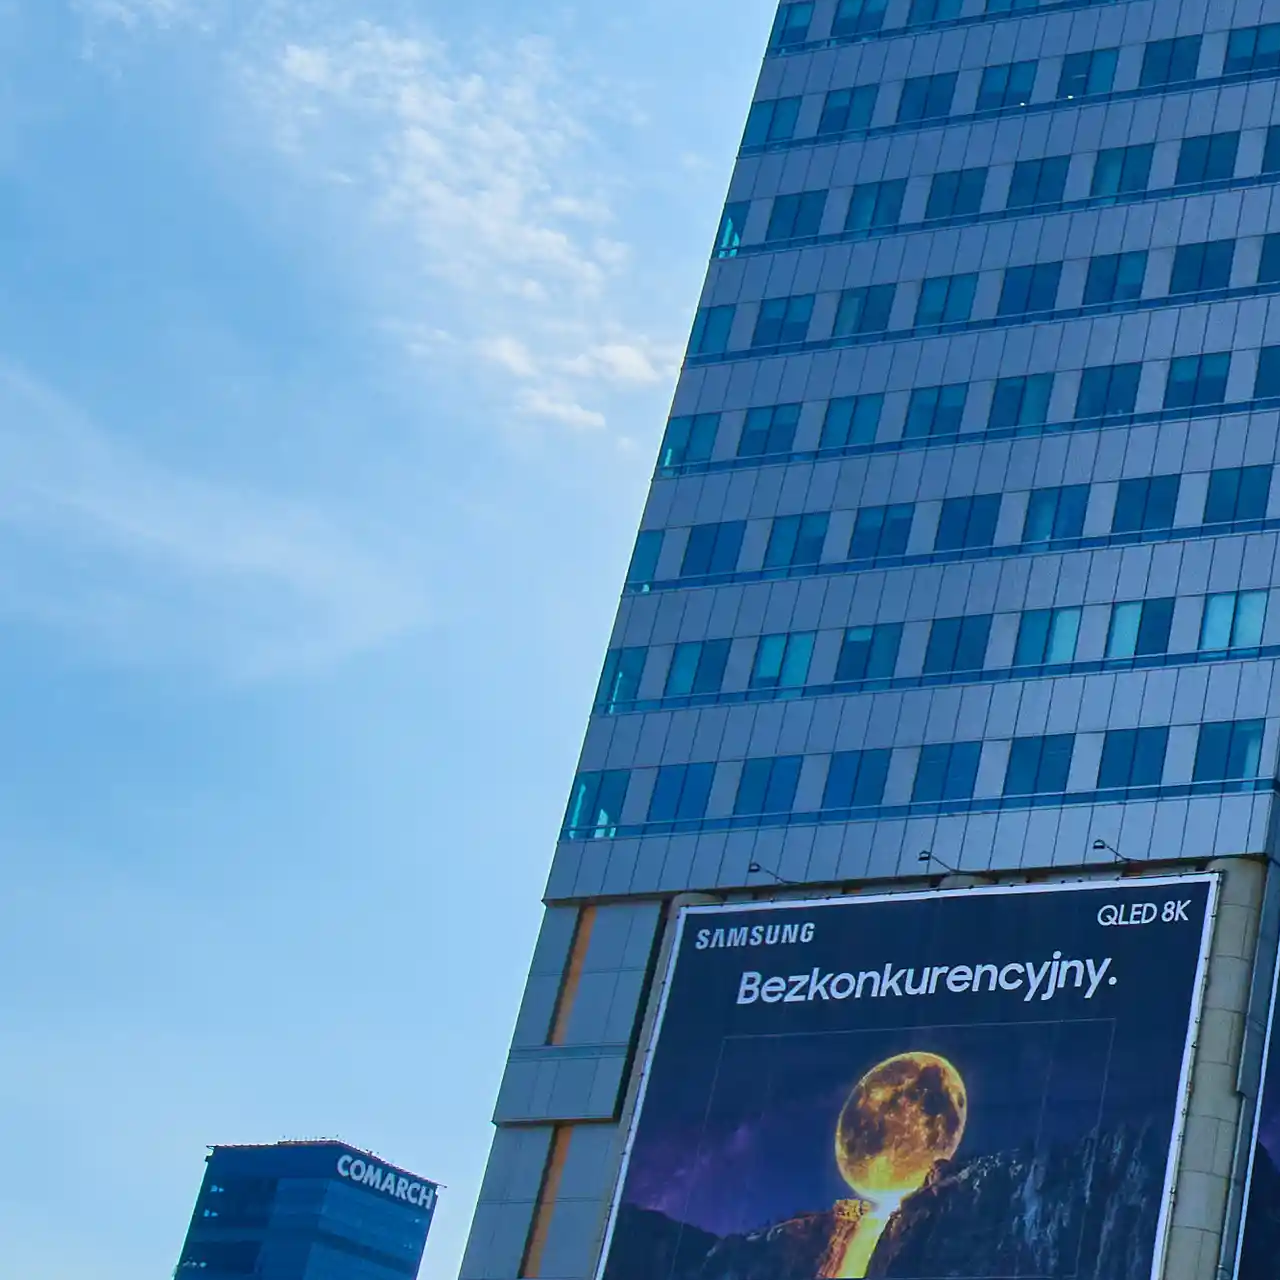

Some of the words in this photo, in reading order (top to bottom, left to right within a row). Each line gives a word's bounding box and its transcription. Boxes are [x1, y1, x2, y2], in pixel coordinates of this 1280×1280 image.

[1097, 904, 1158, 926] QLED
[1161, 900, 1191, 922] 8K
[695, 922, 815, 950] SAMSUNG
[736, 951, 1118, 1005] Bezkonkurencyjny.
[337, 1154, 434, 1210] COMARCH
